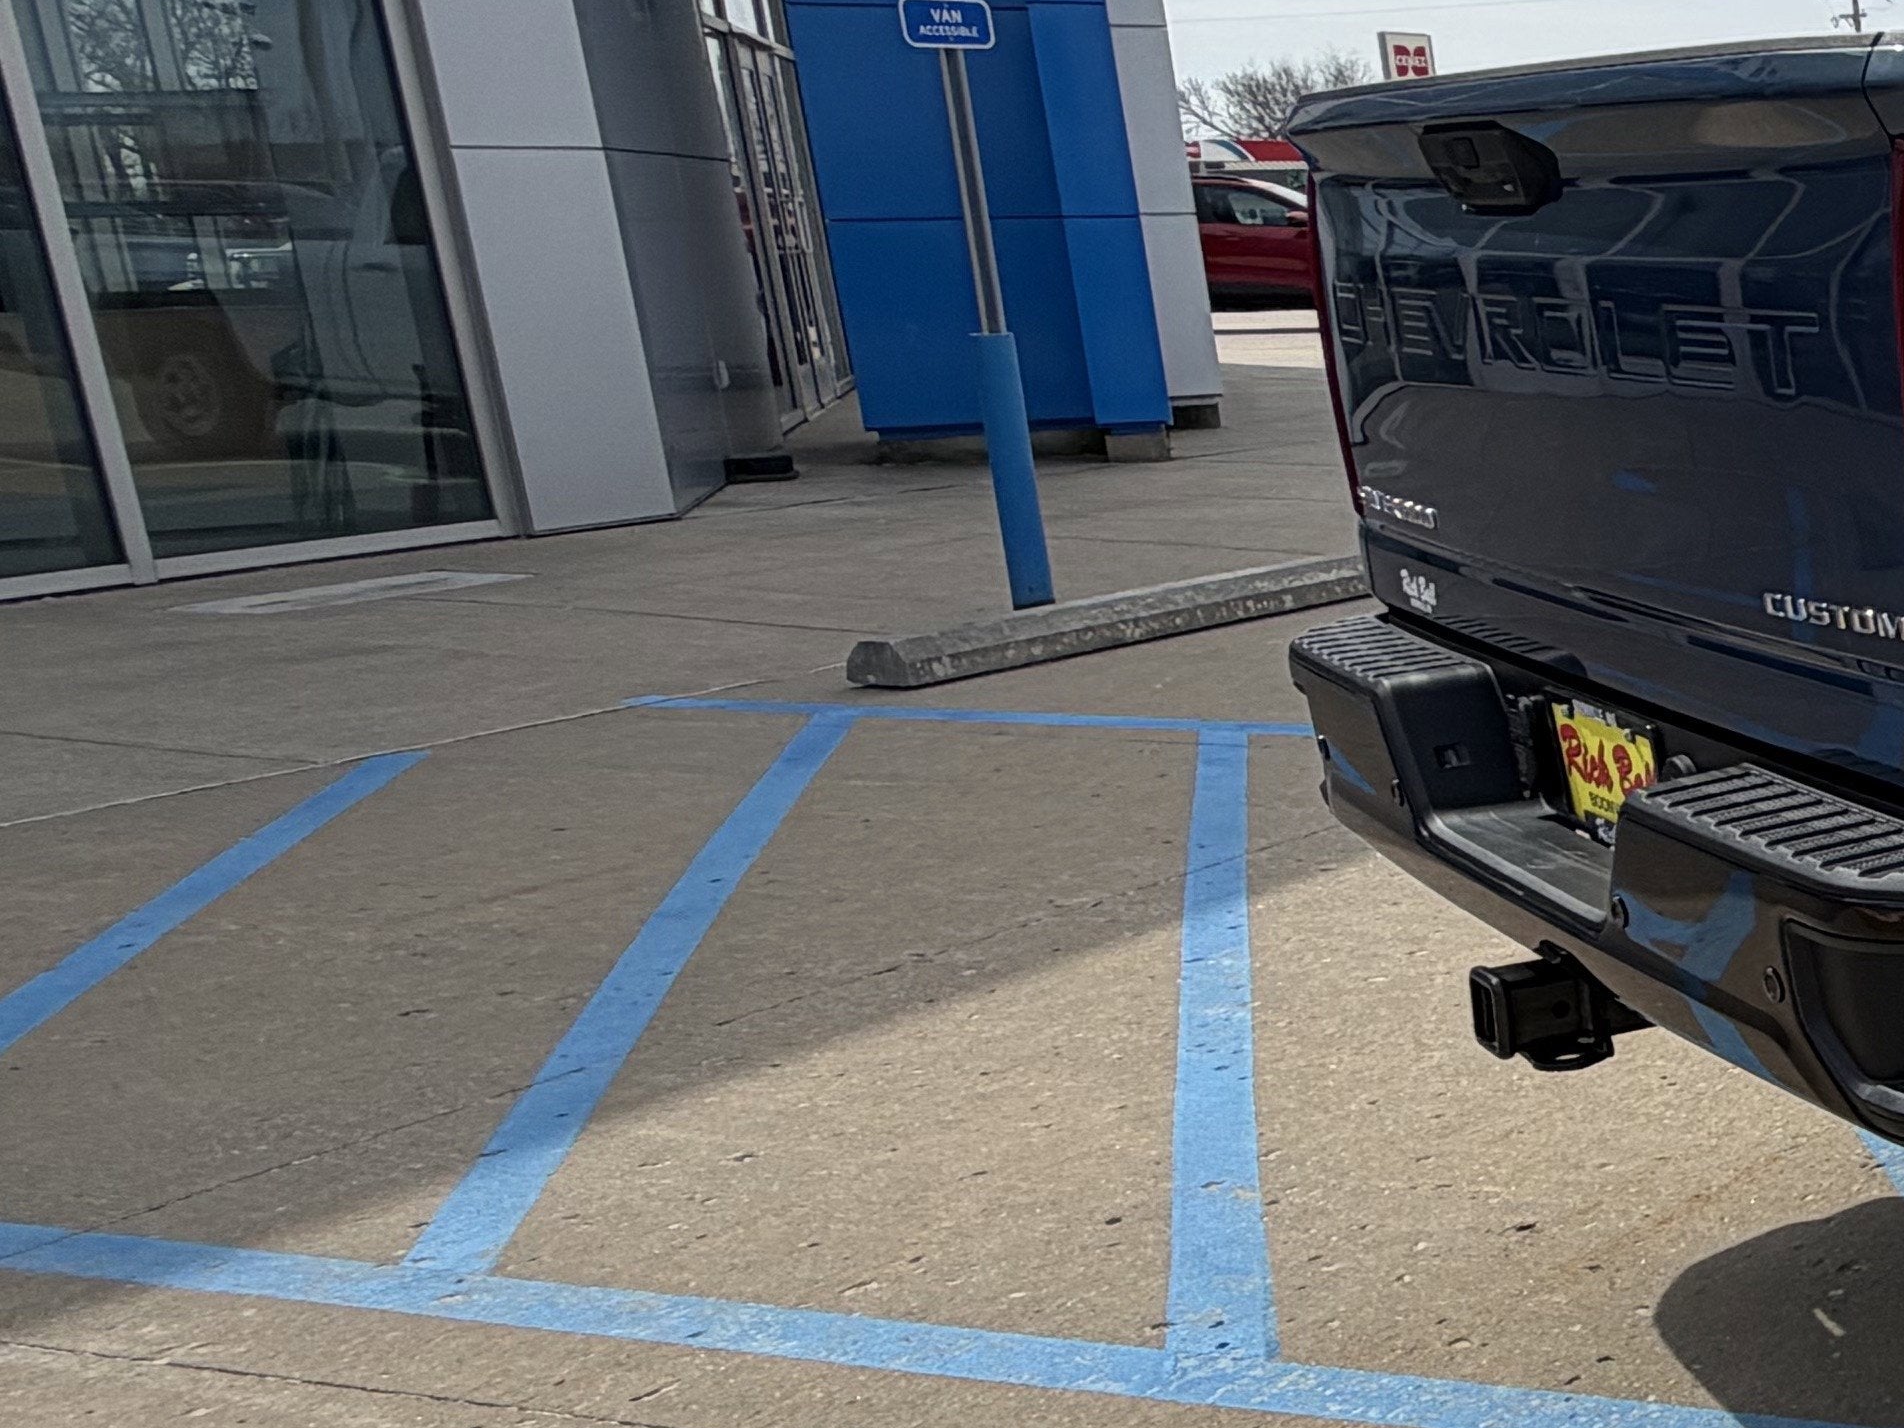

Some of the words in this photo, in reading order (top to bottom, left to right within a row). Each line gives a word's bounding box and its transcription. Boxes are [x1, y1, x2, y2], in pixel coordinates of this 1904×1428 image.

[930, 8, 963, 23] VAN
[919, 25, 979, 37] ACCESSIBLE
[1334, 280, 1820, 396] CHEVROLET
